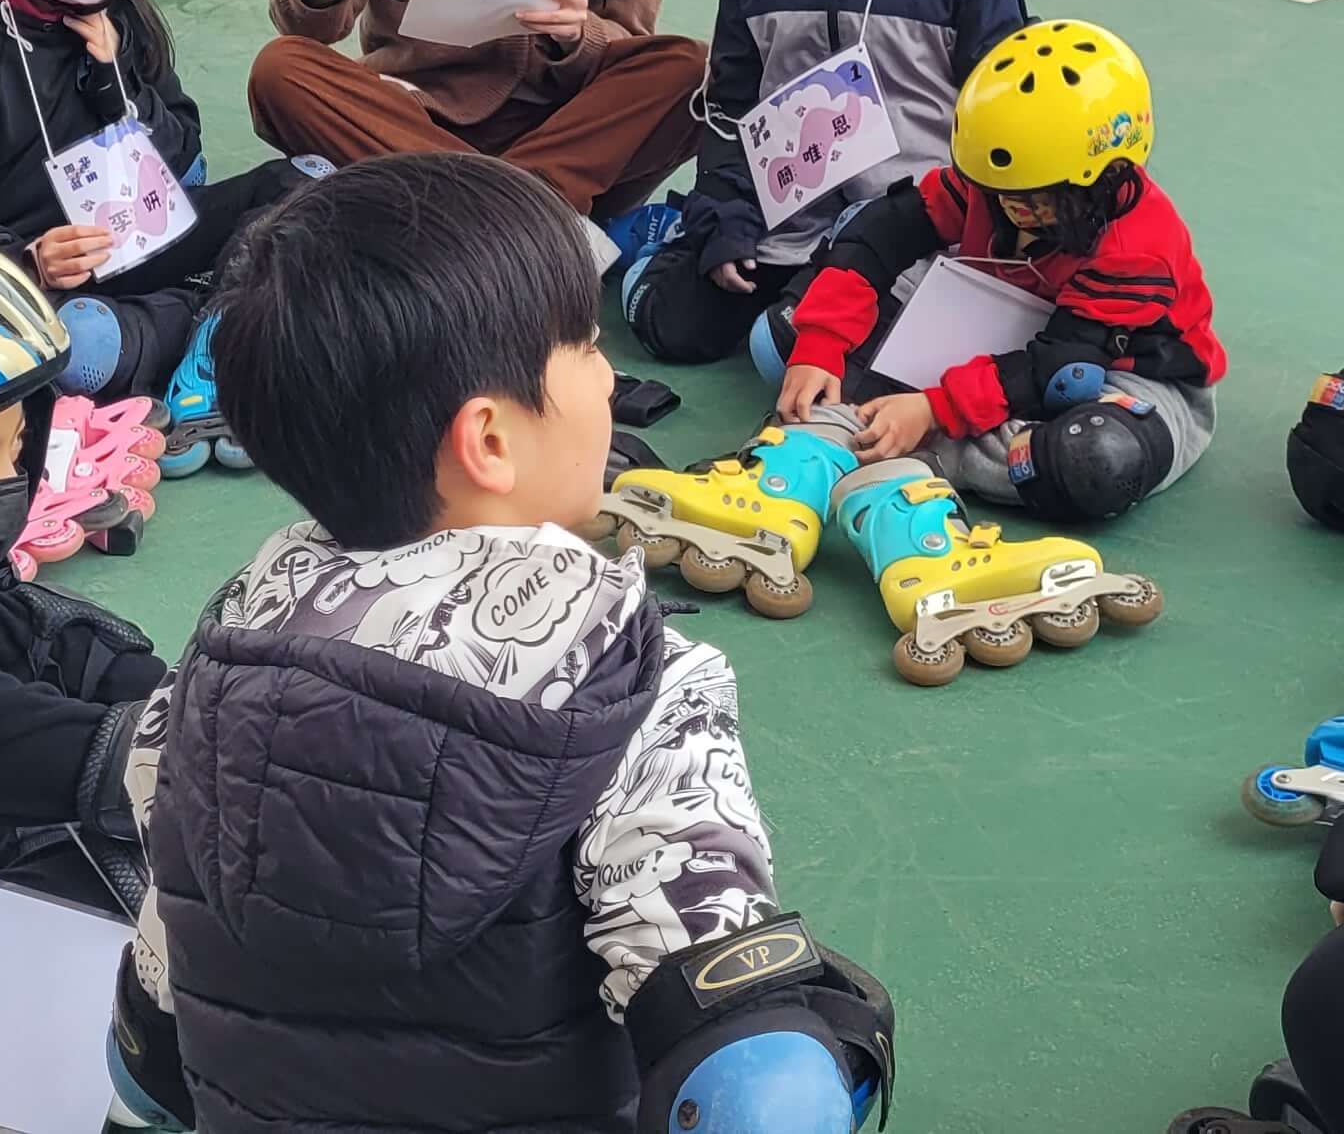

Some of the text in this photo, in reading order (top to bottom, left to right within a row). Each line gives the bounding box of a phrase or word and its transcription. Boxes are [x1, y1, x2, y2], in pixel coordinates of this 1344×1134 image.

[849, 63, 863, 83] 1
[489, 569, 551, 627] COME
[737, 945, 771, 970] VP
